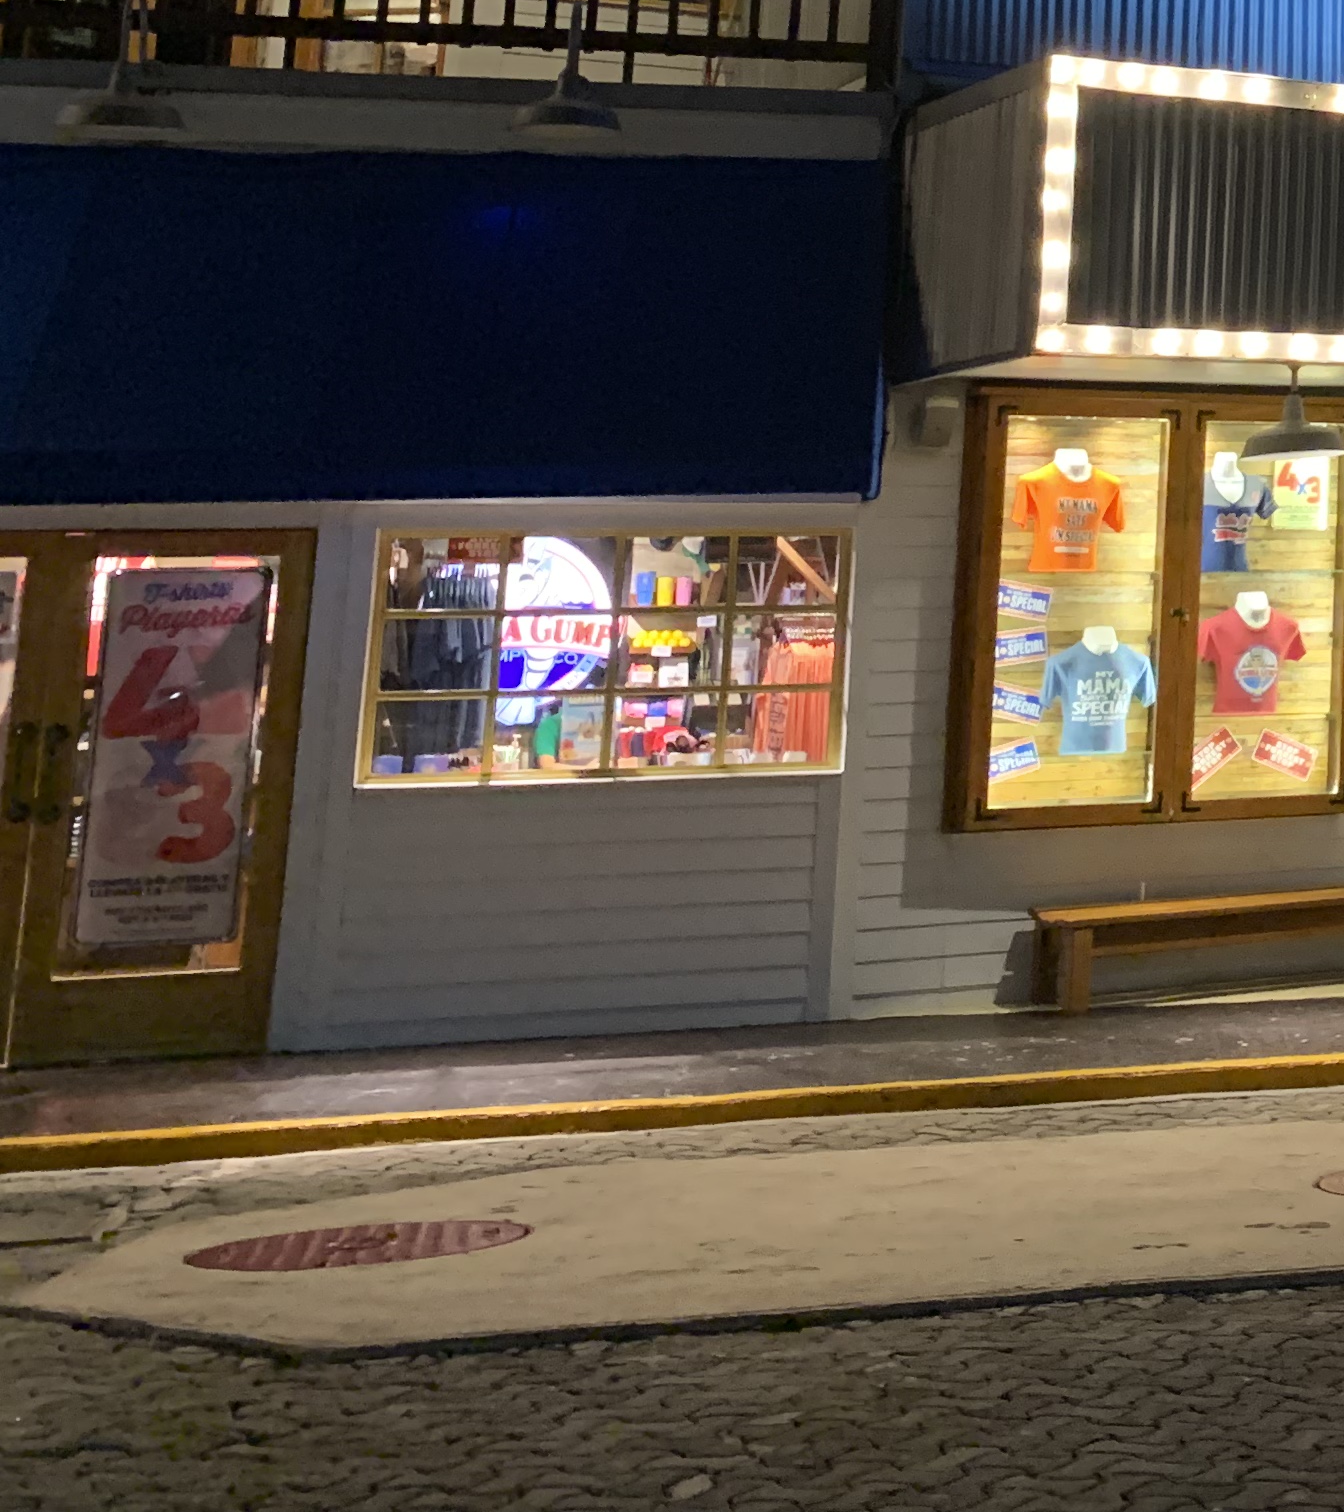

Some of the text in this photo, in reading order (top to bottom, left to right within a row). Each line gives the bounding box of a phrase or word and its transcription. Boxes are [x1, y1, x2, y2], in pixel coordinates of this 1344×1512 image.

[1009, 594, 1048, 614] SPECIAL
[530, 615, 612, 648] GUMP
[1007, 638, 1045, 657] SPECIAL
[102, 645, 200, 741] 4
[1077, 678, 1131, 695] MAMA
[1003, 698, 1041, 718] SPECIAL
[155, 761, 236, 865] 3
